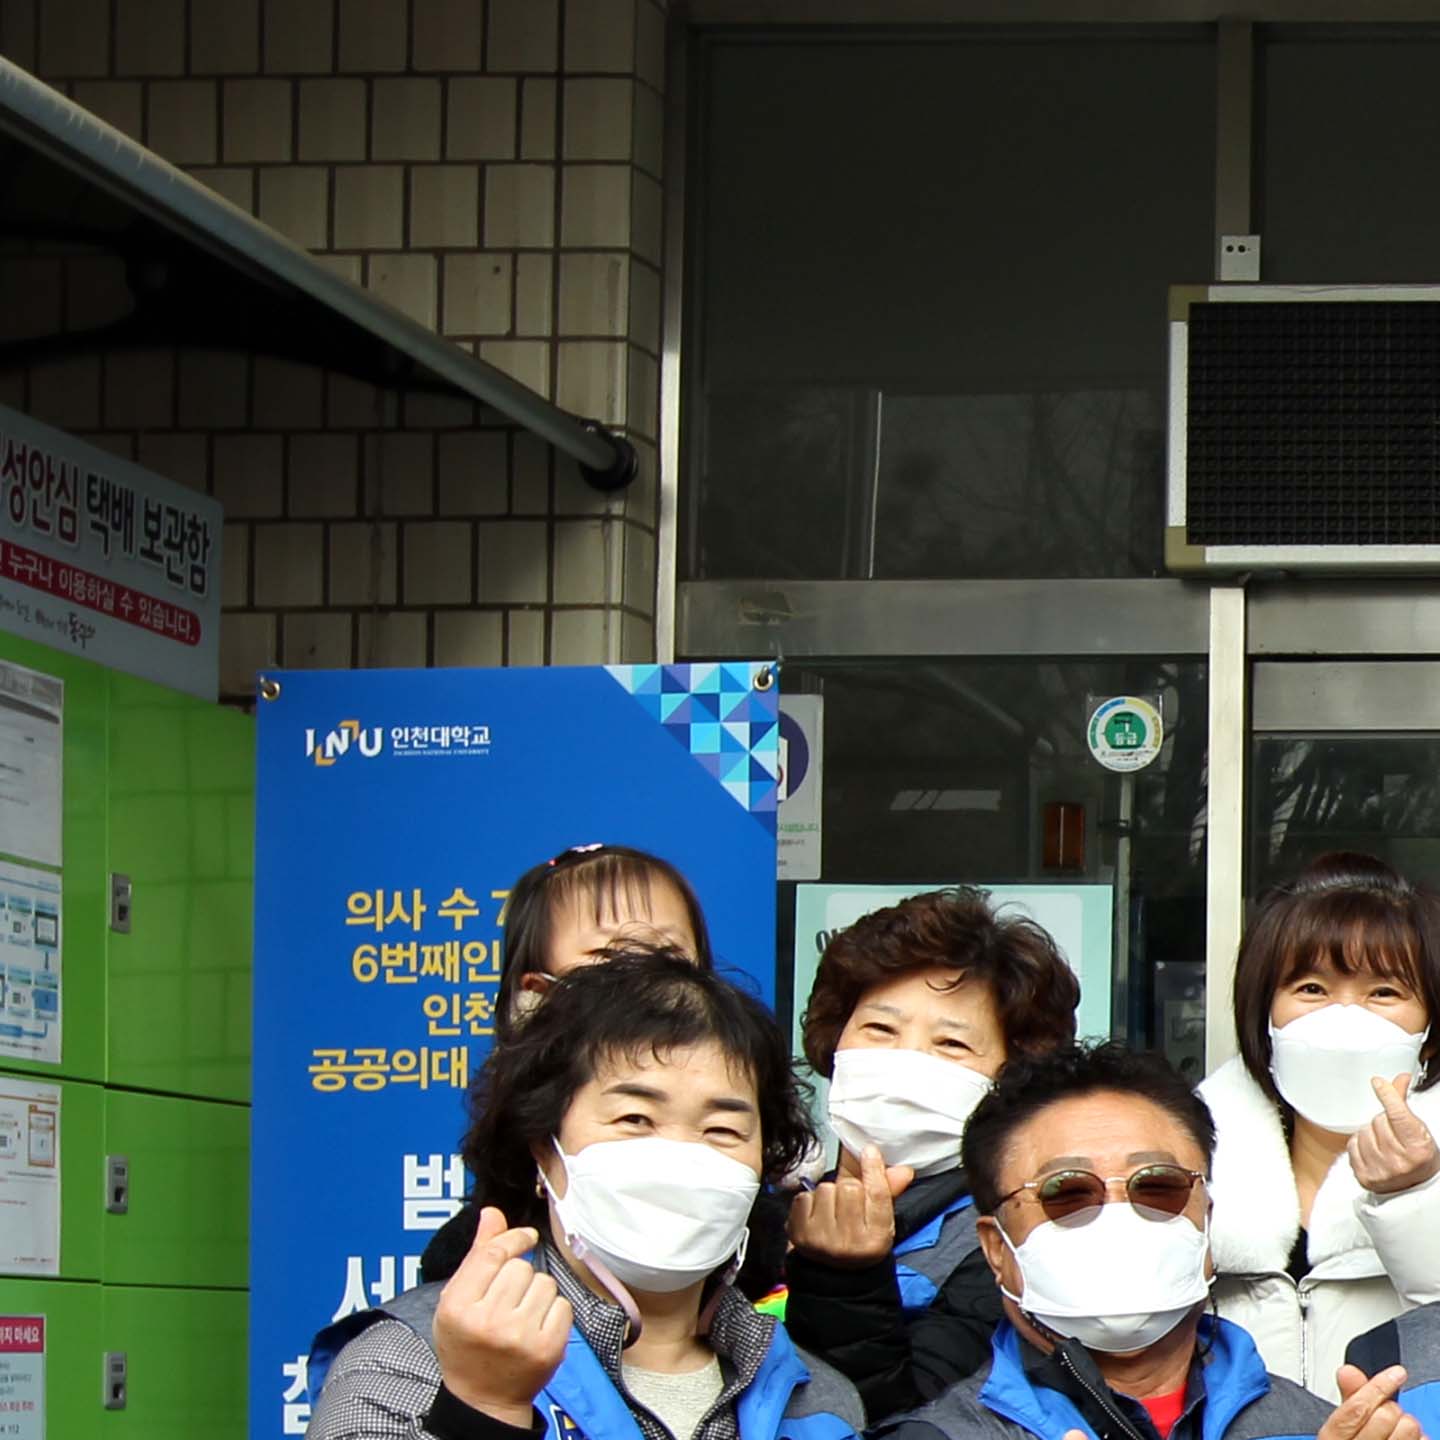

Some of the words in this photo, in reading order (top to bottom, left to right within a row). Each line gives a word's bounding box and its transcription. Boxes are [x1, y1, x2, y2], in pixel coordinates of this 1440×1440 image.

[2, 440, 78, 543] 성안심
[86, 474, 134, 555] 택배
[140, 498, 210, 595] 보관함
[8, 548, 53, 588] 누구나
[59, 568, 115, 611] 이용하실
[120, 593, 134, 616] 수
[391, 726, 491, 749] 인천대학교
[346, 888, 427, 932] 의사
[438, 888, 479, 931] 수
[352, 940, 501, 984] 6번째인
[423, 993, 499, 1036] 인천
[308, 1046, 468, 1092] 공공의대
